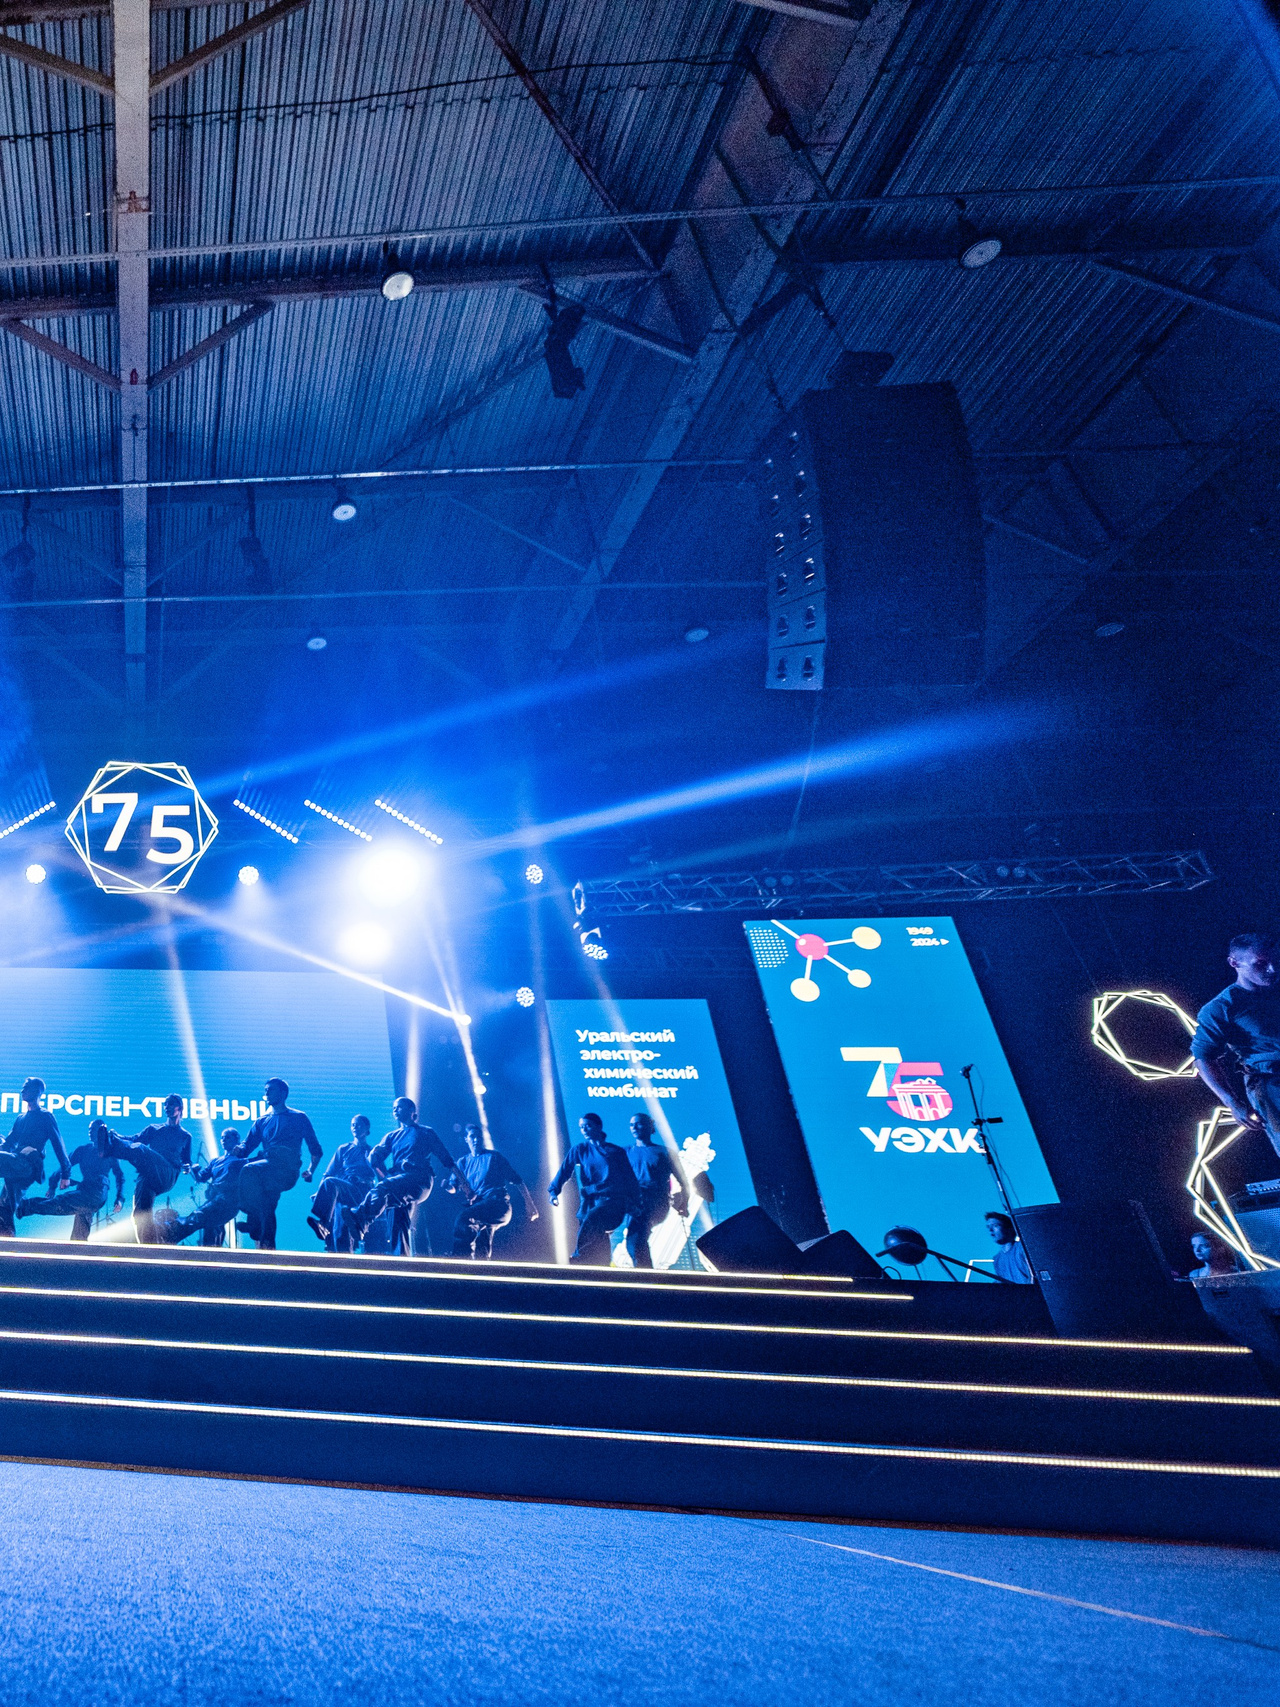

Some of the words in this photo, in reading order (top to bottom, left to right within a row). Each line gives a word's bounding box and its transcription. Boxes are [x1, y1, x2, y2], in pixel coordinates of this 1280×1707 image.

[91, 792, 195, 865] 75
[910, 937, 941, 947] 2024
[575, 1029, 676, 1045] Уральский
[579, 1049, 661, 1063] электро-
[583, 1065, 699, 1080] химический
[587, 1083, 679, 1099] комбинат
[839, 1046, 954, 1122] 75
[858, 1126, 987, 1154] УЭХК
